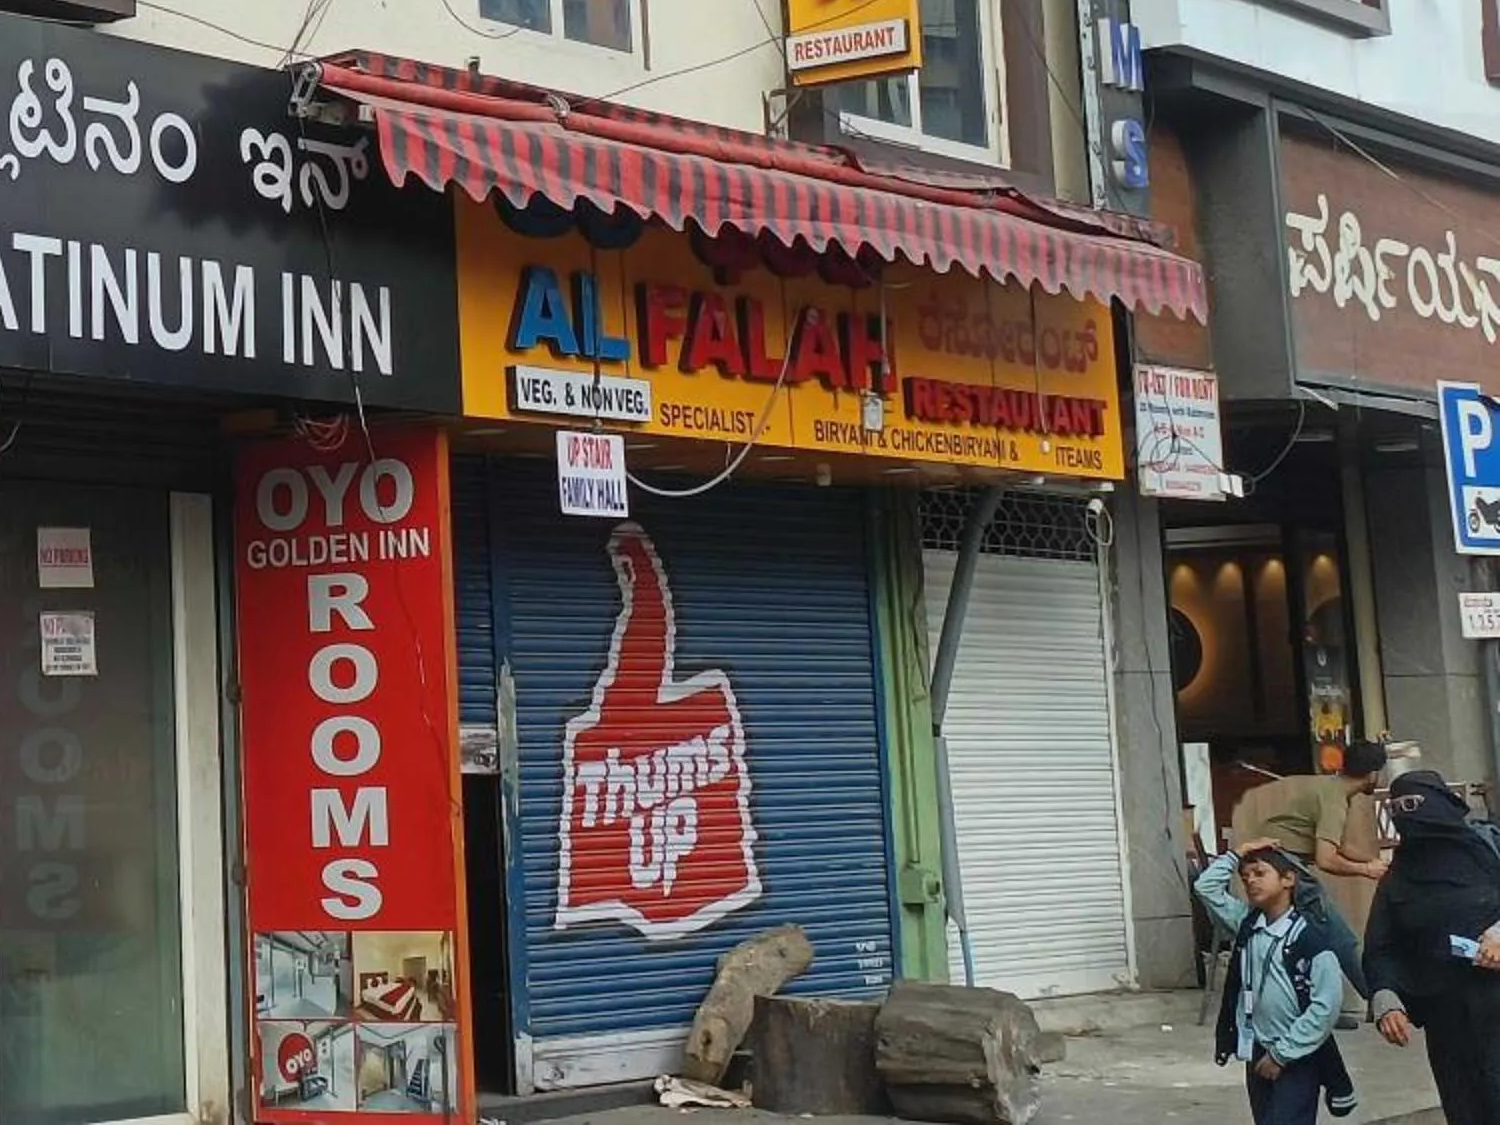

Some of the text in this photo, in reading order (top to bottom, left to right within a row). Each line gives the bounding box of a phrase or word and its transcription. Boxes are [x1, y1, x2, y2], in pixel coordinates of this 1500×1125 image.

[794, 27, 895, 62] RESTAURANT
[282, 270, 393, 377] INN
[508, 264, 898, 394] AL FALAH
[521, 378, 557, 406] VEG.
[565, 382, 575, 407] &
[903, 377, 1108, 437] RESTAURANT
[660, 402, 754, 435] SPECIALIST
[1457, 399, 1492, 478] P
[256, 459, 415, 531] OYO
[597, 478, 624, 511] HALL
[247, 528, 431, 569] GOLDEN INN
[307, 572, 389, 921] ROOMS
[286, 1048, 313, 1074] OYO
